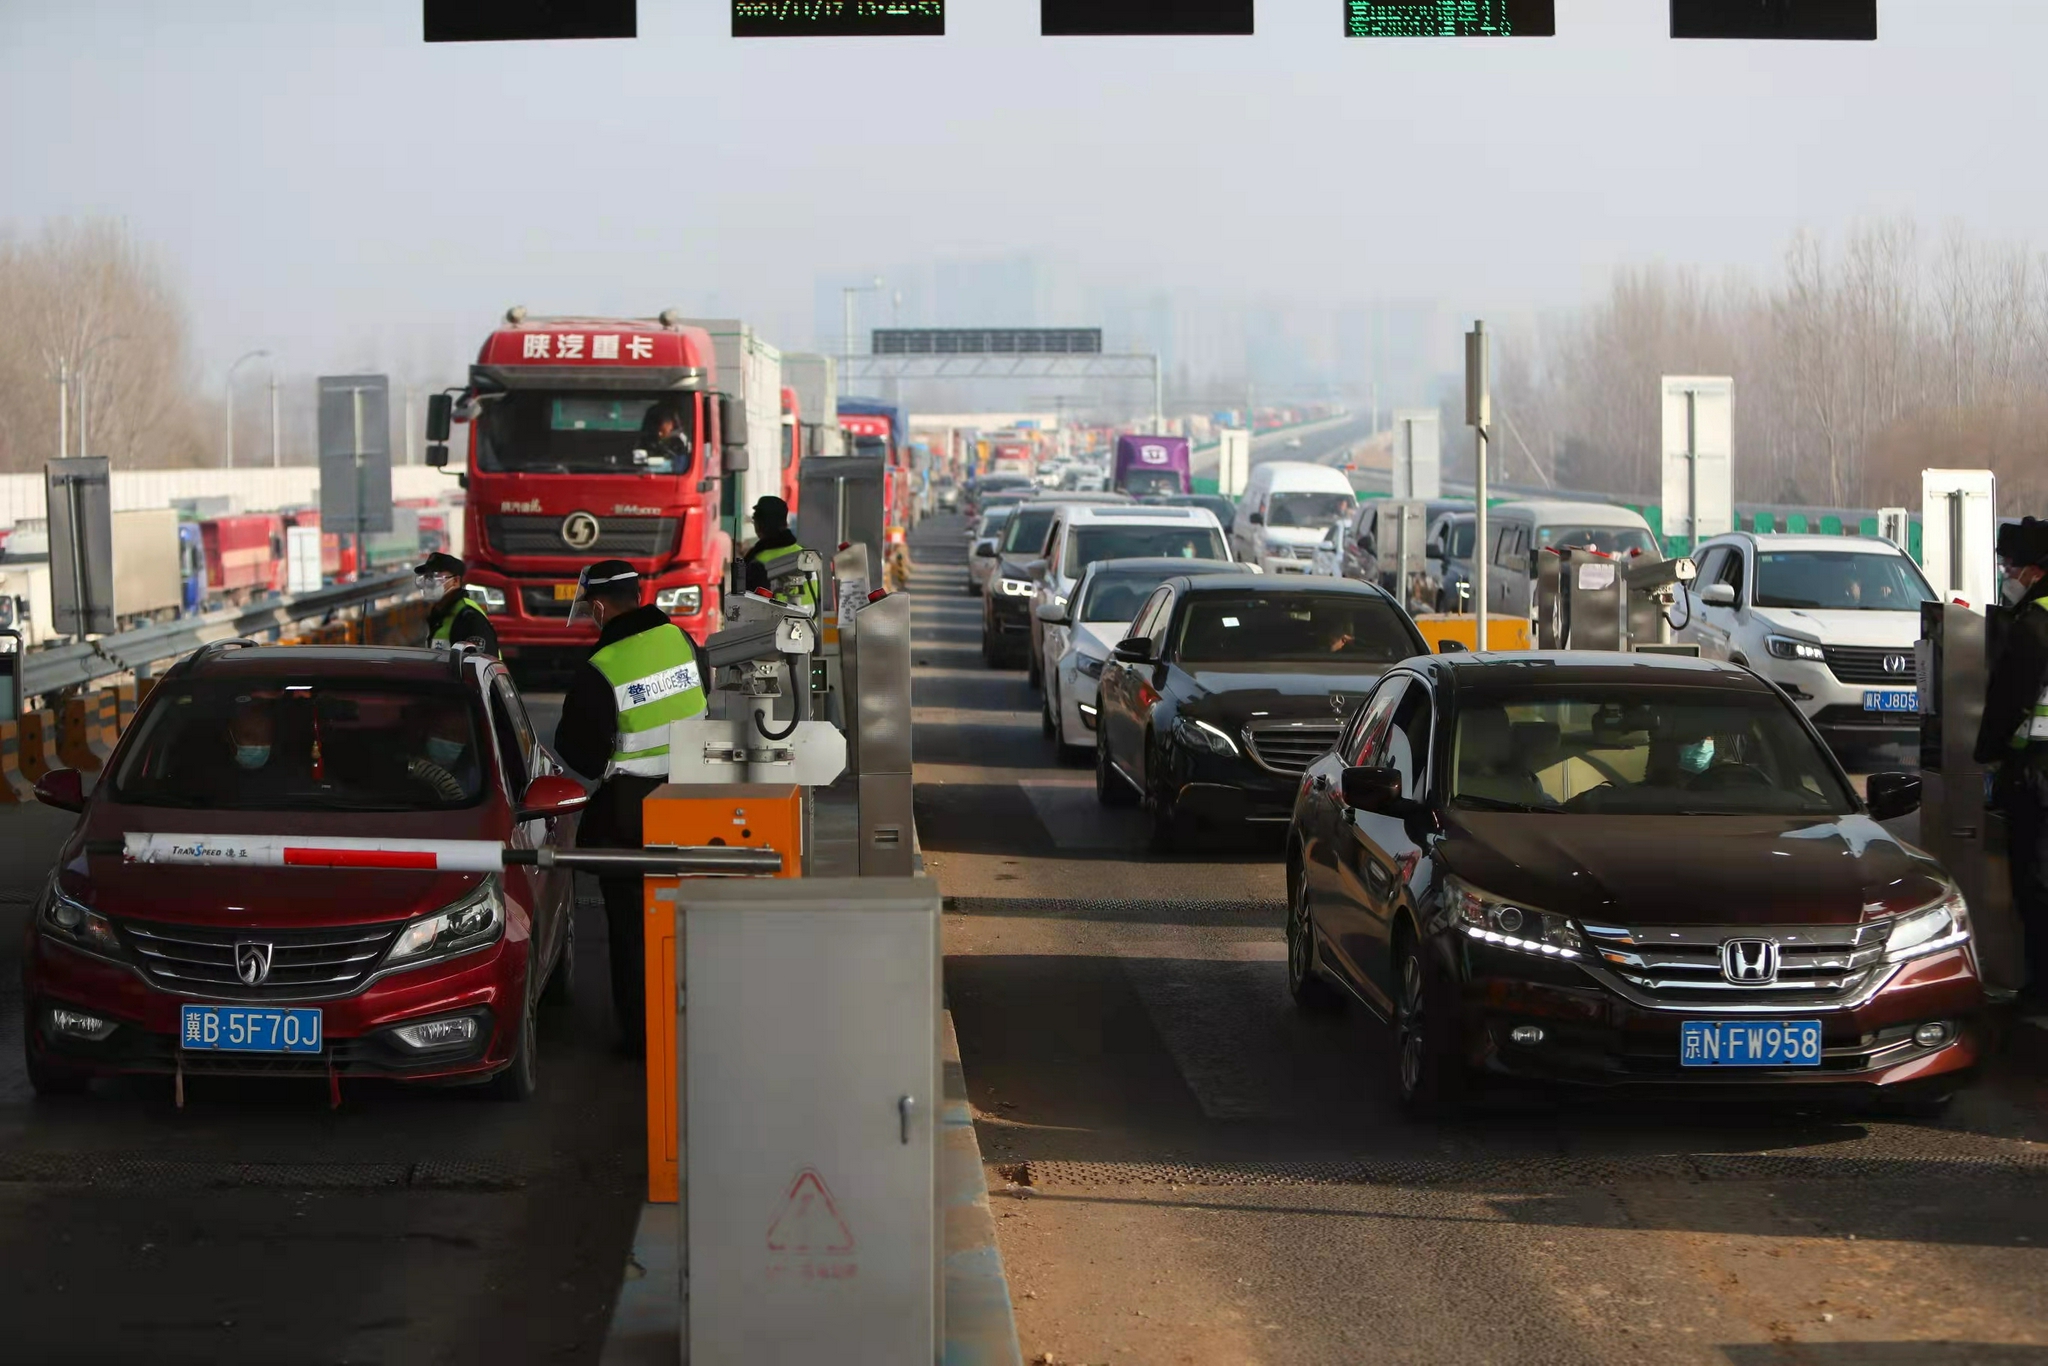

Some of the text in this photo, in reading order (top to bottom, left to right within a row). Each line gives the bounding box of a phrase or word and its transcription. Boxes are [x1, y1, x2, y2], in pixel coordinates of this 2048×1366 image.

[523, 334, 653, 359] 陕汽重卡
[186, 1012, 318, 1046] 冀B·5F70J
[1685, 1028, 1818, 1059] 京N·FW958
